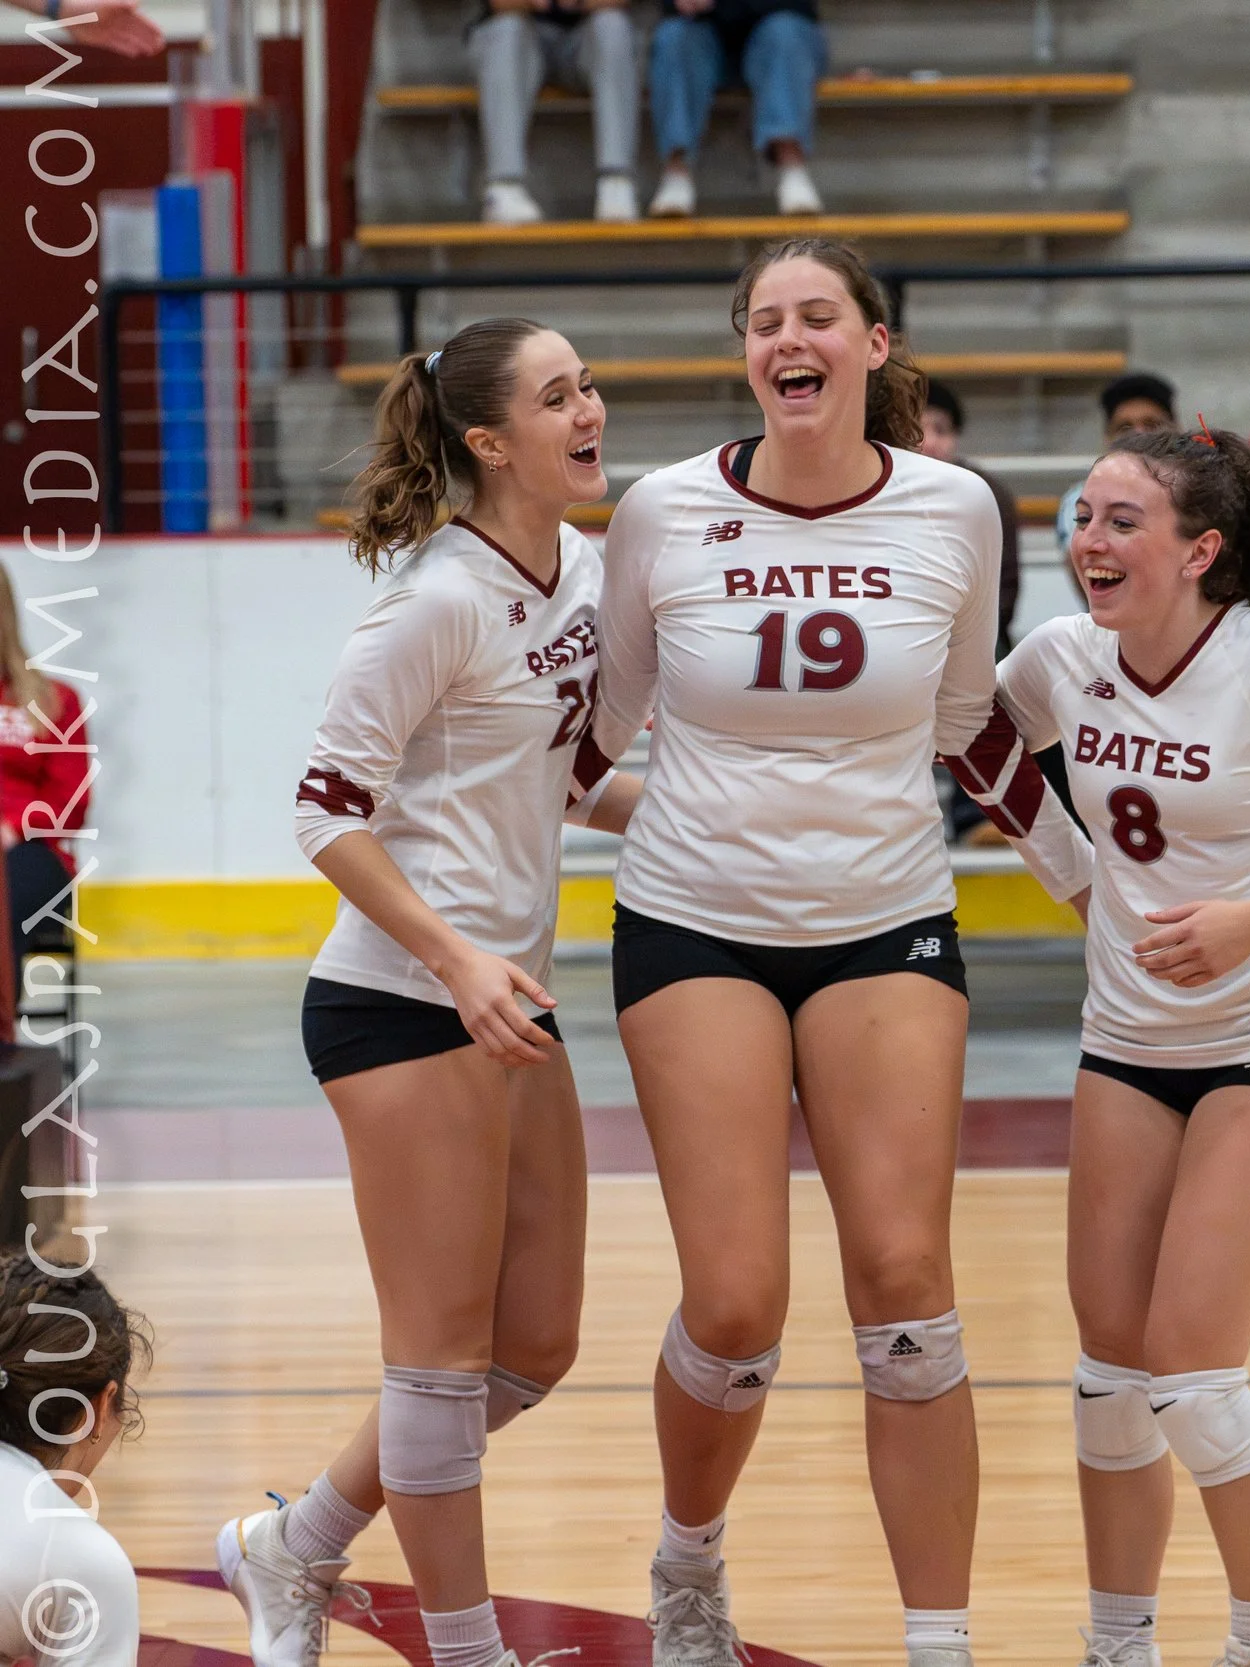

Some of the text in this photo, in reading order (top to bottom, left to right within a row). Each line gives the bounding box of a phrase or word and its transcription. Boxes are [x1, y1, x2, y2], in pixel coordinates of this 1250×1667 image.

[723, 565, 892, 599] BATES
[744, 609, 868, 692] 19
[1074, 724, 1211, 783] BATES
[1106, 784, 1168, 865] 8
